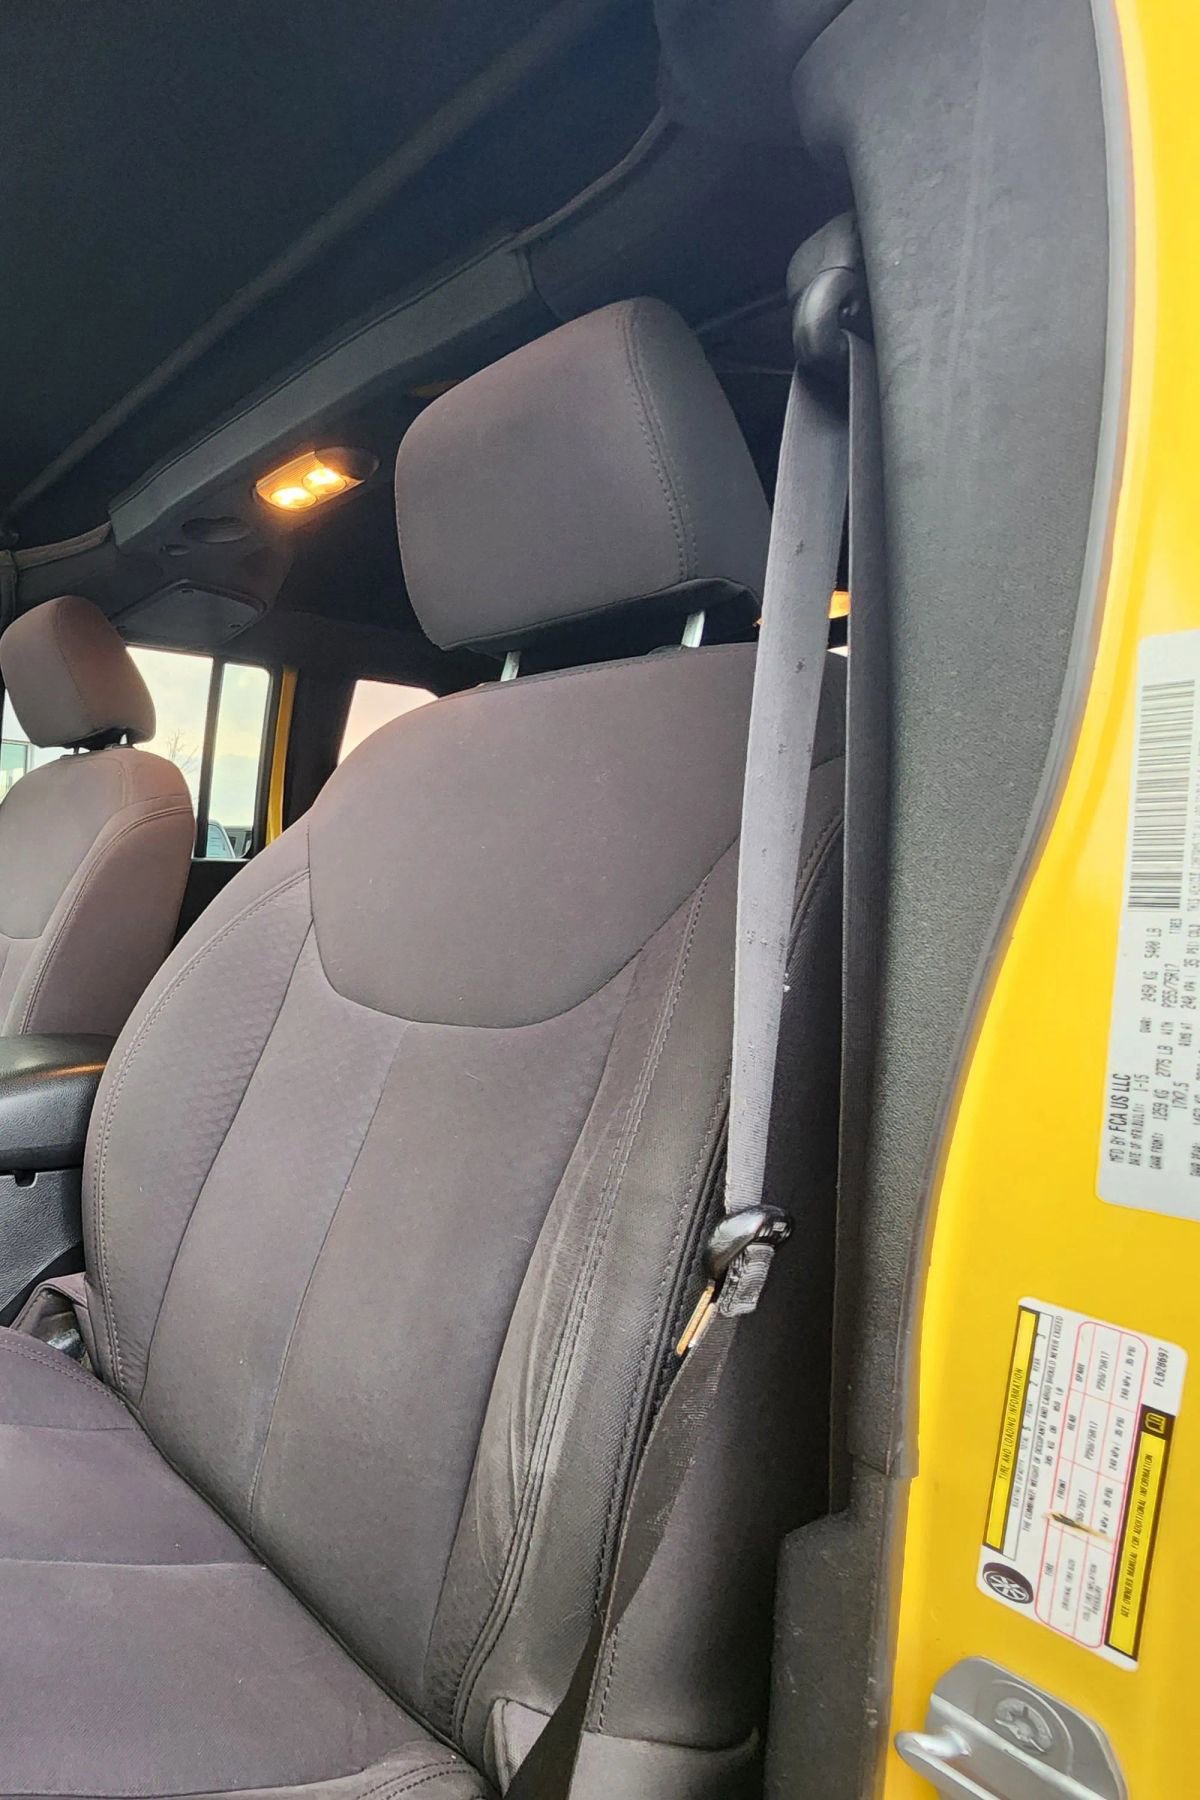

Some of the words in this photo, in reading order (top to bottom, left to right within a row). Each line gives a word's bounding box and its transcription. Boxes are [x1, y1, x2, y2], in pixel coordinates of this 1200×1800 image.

[1155, 1044, 1173, 1055] LB
[1153, 1058, 1172, 1077] 2775
[1110, 1073, 1131, 1092] LLC
[1132, 1073, 1150, 1092] 1-15
[1109, 1094, 1129, 1109] US
[1107, 1113, 1128, 1132] FCA
[1039, 1405, 1049, 1419] AND
[1049, 1338, 1059, 1360] NEVER
[1007, 1366, 1024, 1416] INFORMATION
[1002, 1415, 1017, 1448] LOADING
[1066, 1413, 1077, 1432] REAR
[1000, 1446, 1012, 1464] AND
[997, 1463, 1010, 1480] TIRE
[1125, 1550, 1138, 1577] MANUAL
[1137, 1452, 1154, 1497] INFORMATION
